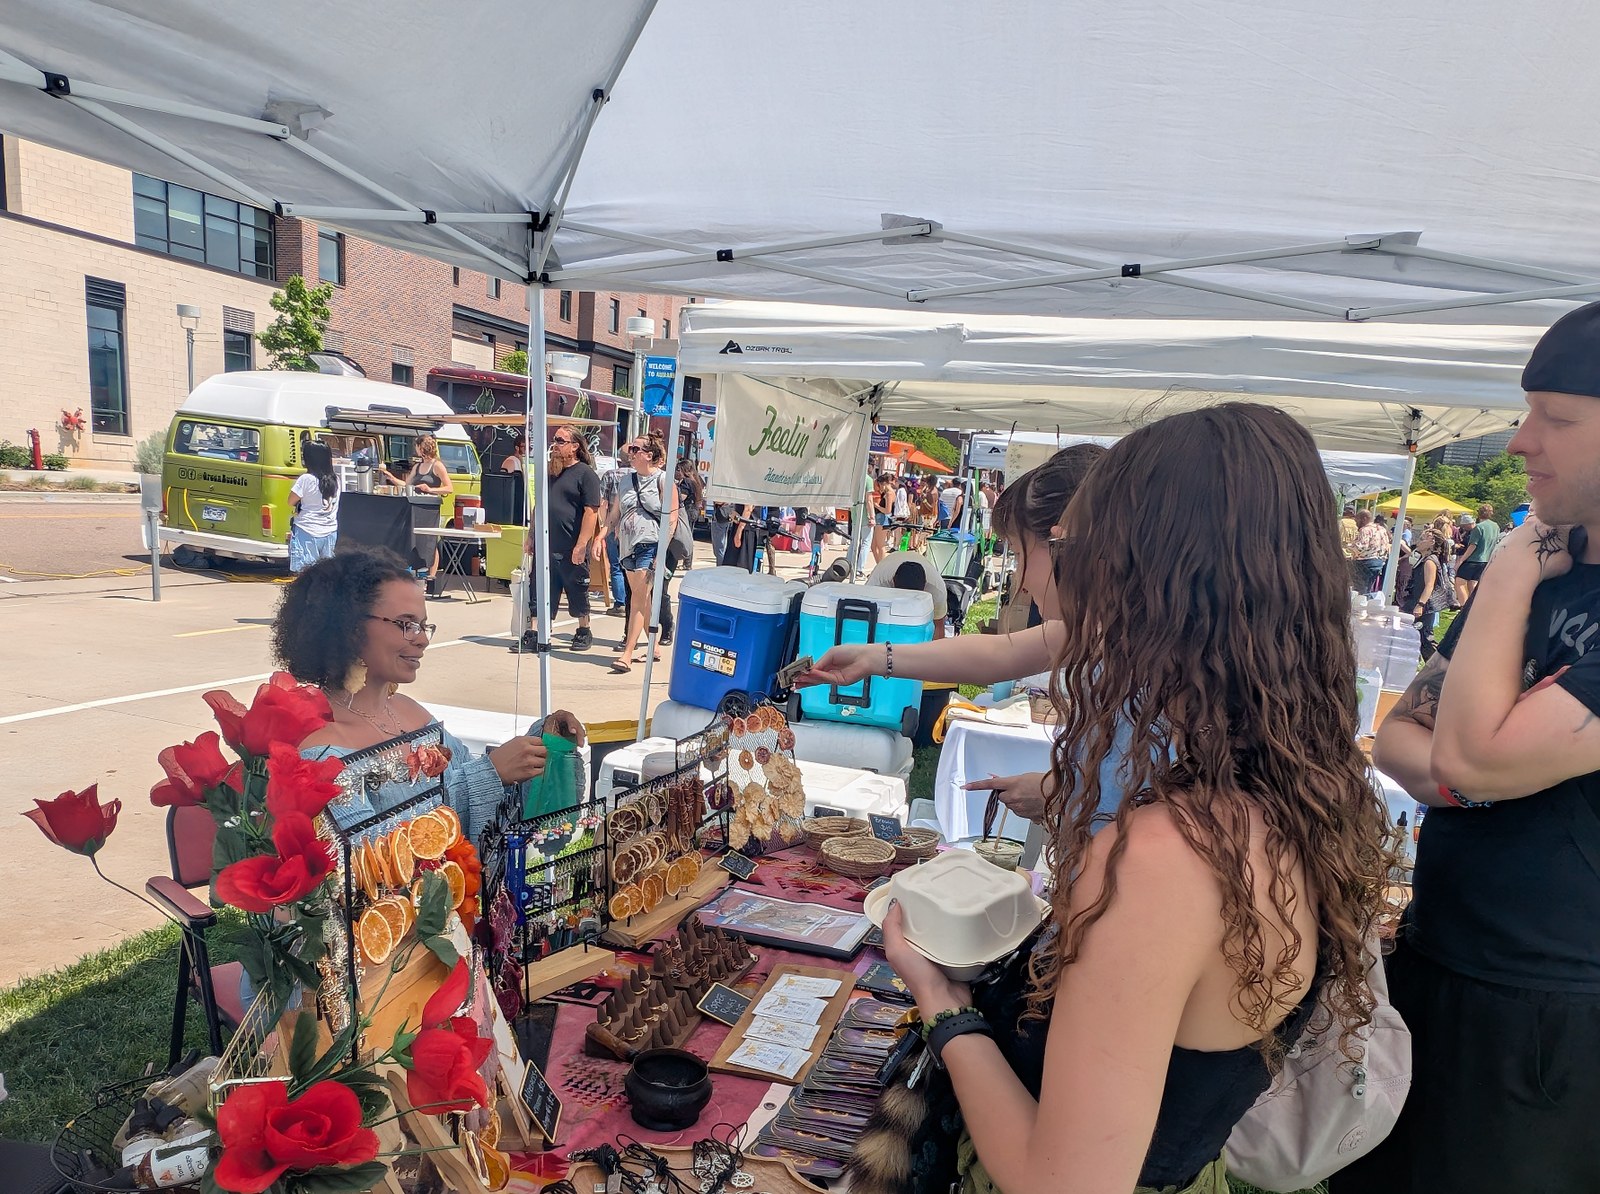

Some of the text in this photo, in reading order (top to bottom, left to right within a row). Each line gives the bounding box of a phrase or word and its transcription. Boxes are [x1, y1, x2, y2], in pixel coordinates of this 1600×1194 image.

[648, 363, 673, 371] WELCOME
[703, 644, 725, 654] IGLOO
[693, 652, 701, 661] 4
